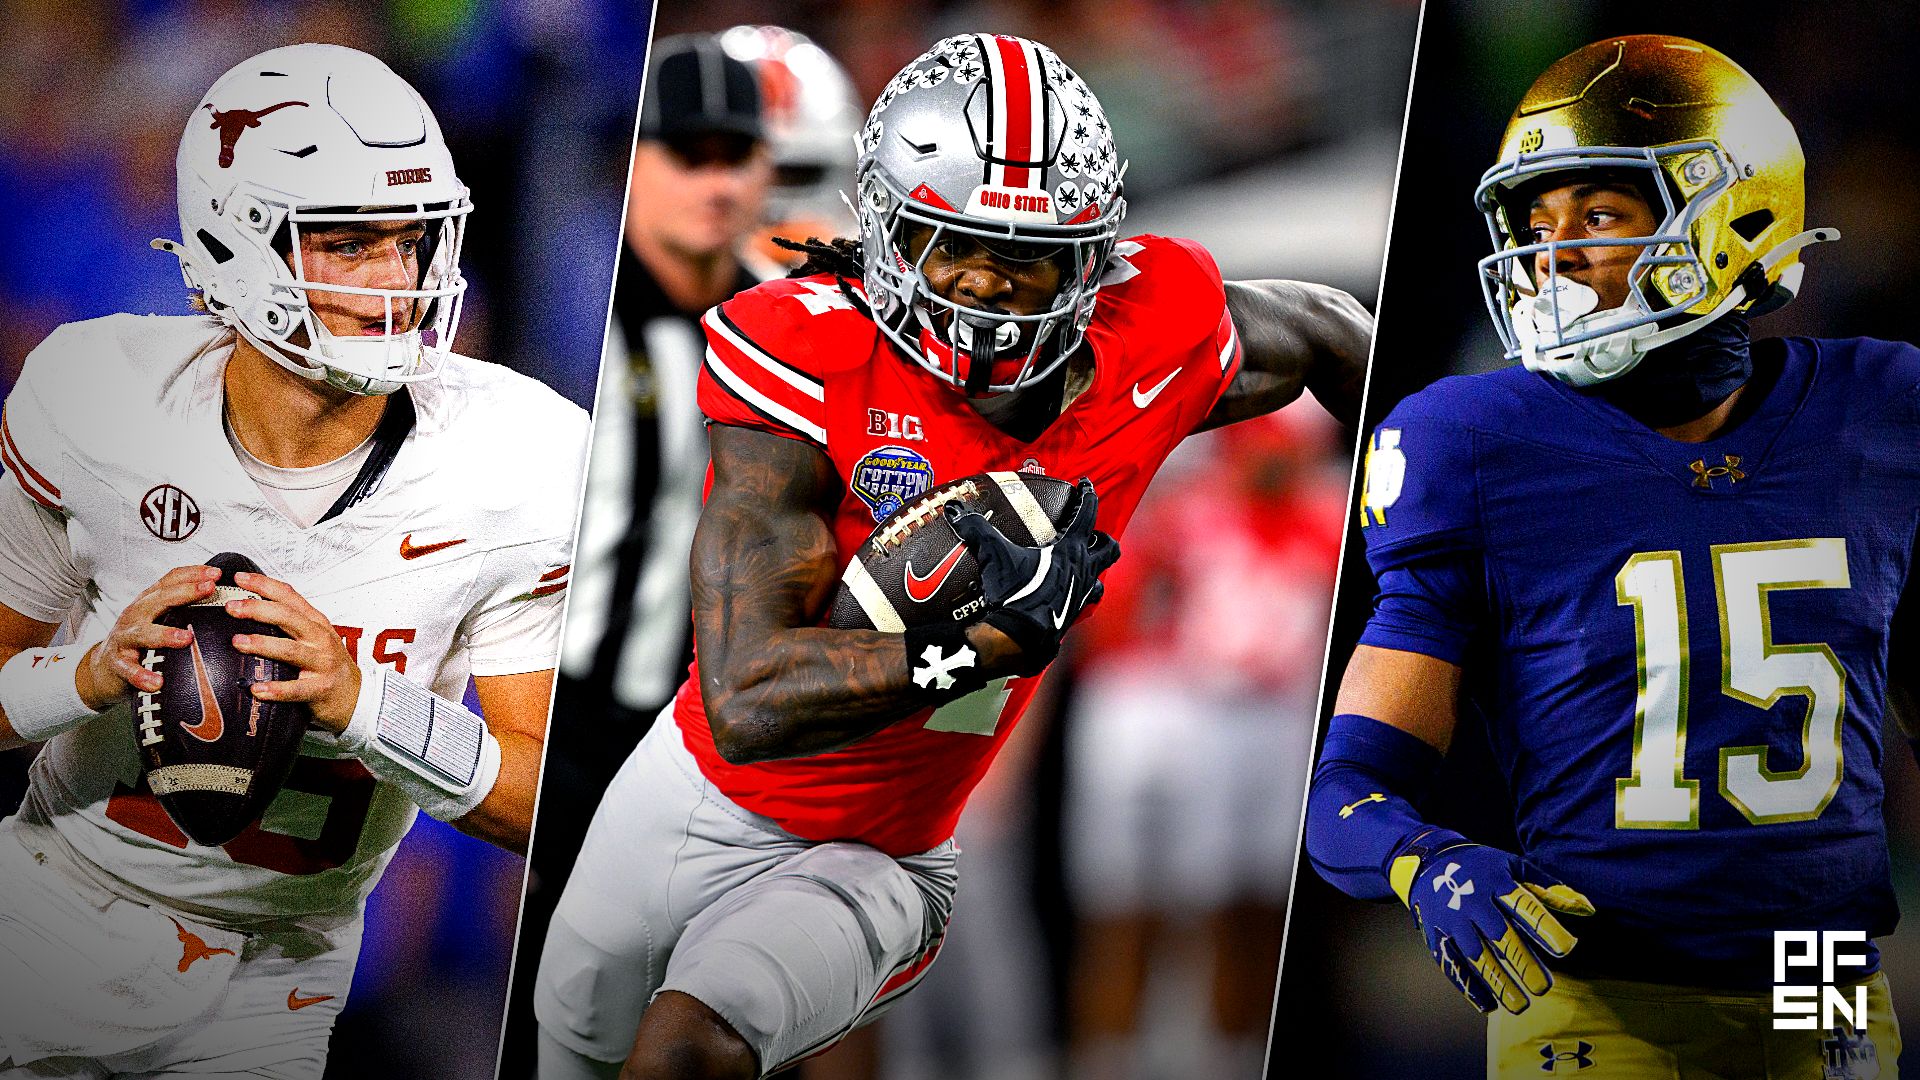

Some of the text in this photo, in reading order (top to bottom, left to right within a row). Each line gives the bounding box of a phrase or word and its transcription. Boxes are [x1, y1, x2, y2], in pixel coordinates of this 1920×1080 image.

[385, 168, 432, 186] HORNS
[980, 190, 1049, 213] OHIO STATE
[865, 457, 927, 471] GOODYEAR
[859, 468, 928, 496] COTTON
[870, 482, 914, 499] BOWL
[144, 487, 198, 539] SEC
[1615, 538, 1851, 830] 15
